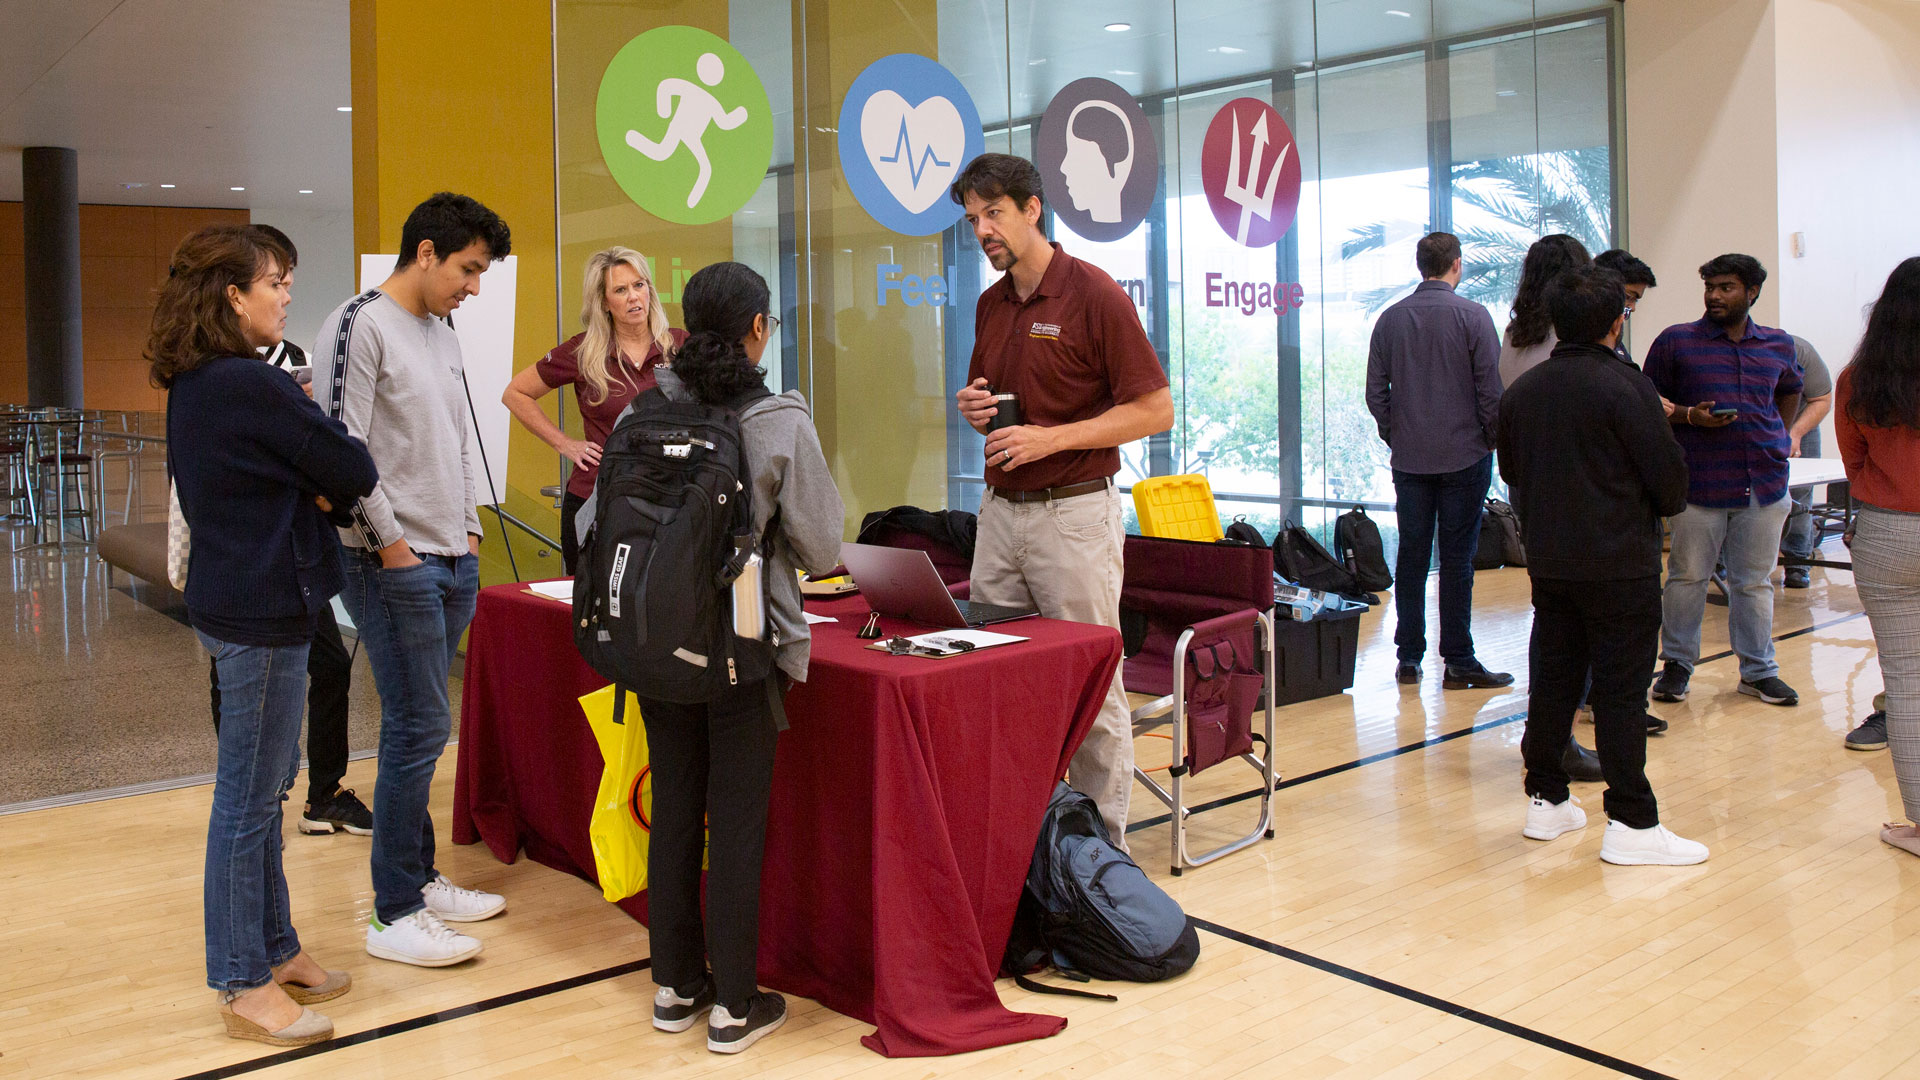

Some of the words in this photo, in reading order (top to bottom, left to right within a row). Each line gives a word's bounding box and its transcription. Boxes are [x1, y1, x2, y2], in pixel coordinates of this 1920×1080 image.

[877, 264, 956, 307] Feel
[1205, 272, 1304, 316] Engage
[612, 573, 620, 591] SWISS
[616, 556, 624, 573] GEAR
